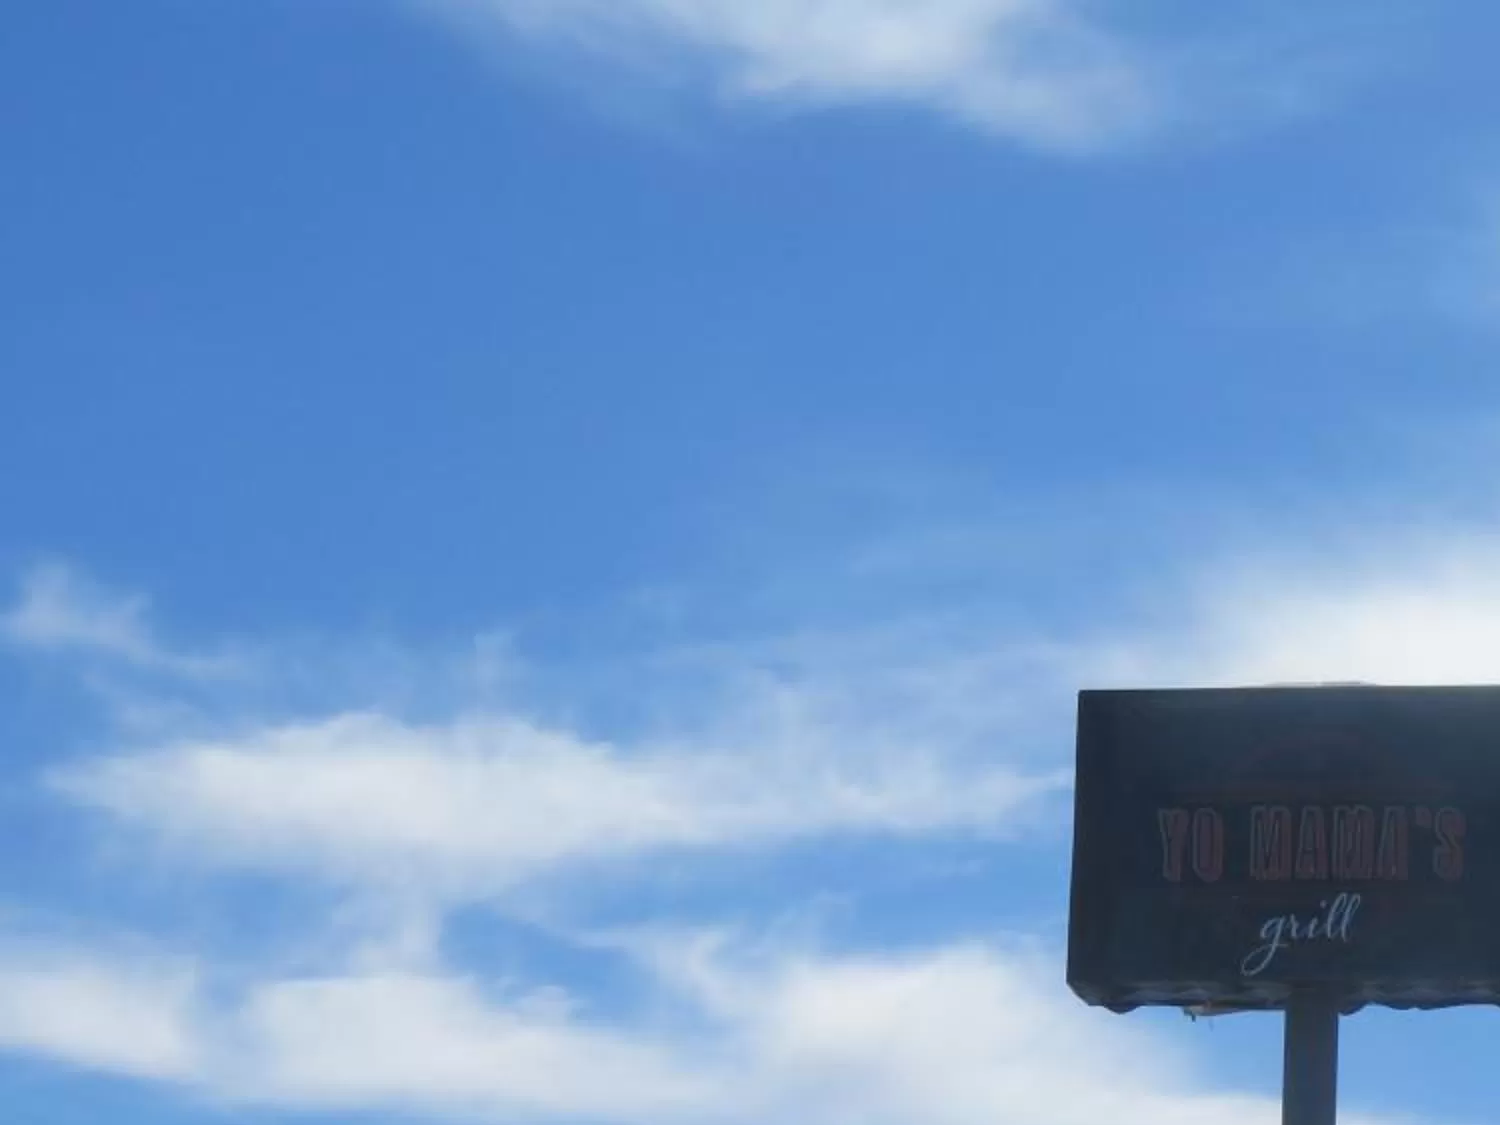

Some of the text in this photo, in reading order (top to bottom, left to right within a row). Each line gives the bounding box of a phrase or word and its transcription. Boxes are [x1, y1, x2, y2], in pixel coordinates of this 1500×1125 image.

[1156, 803, 1468, 883] YO MAMA'S
[1240, 891, 1362, 977] grill
